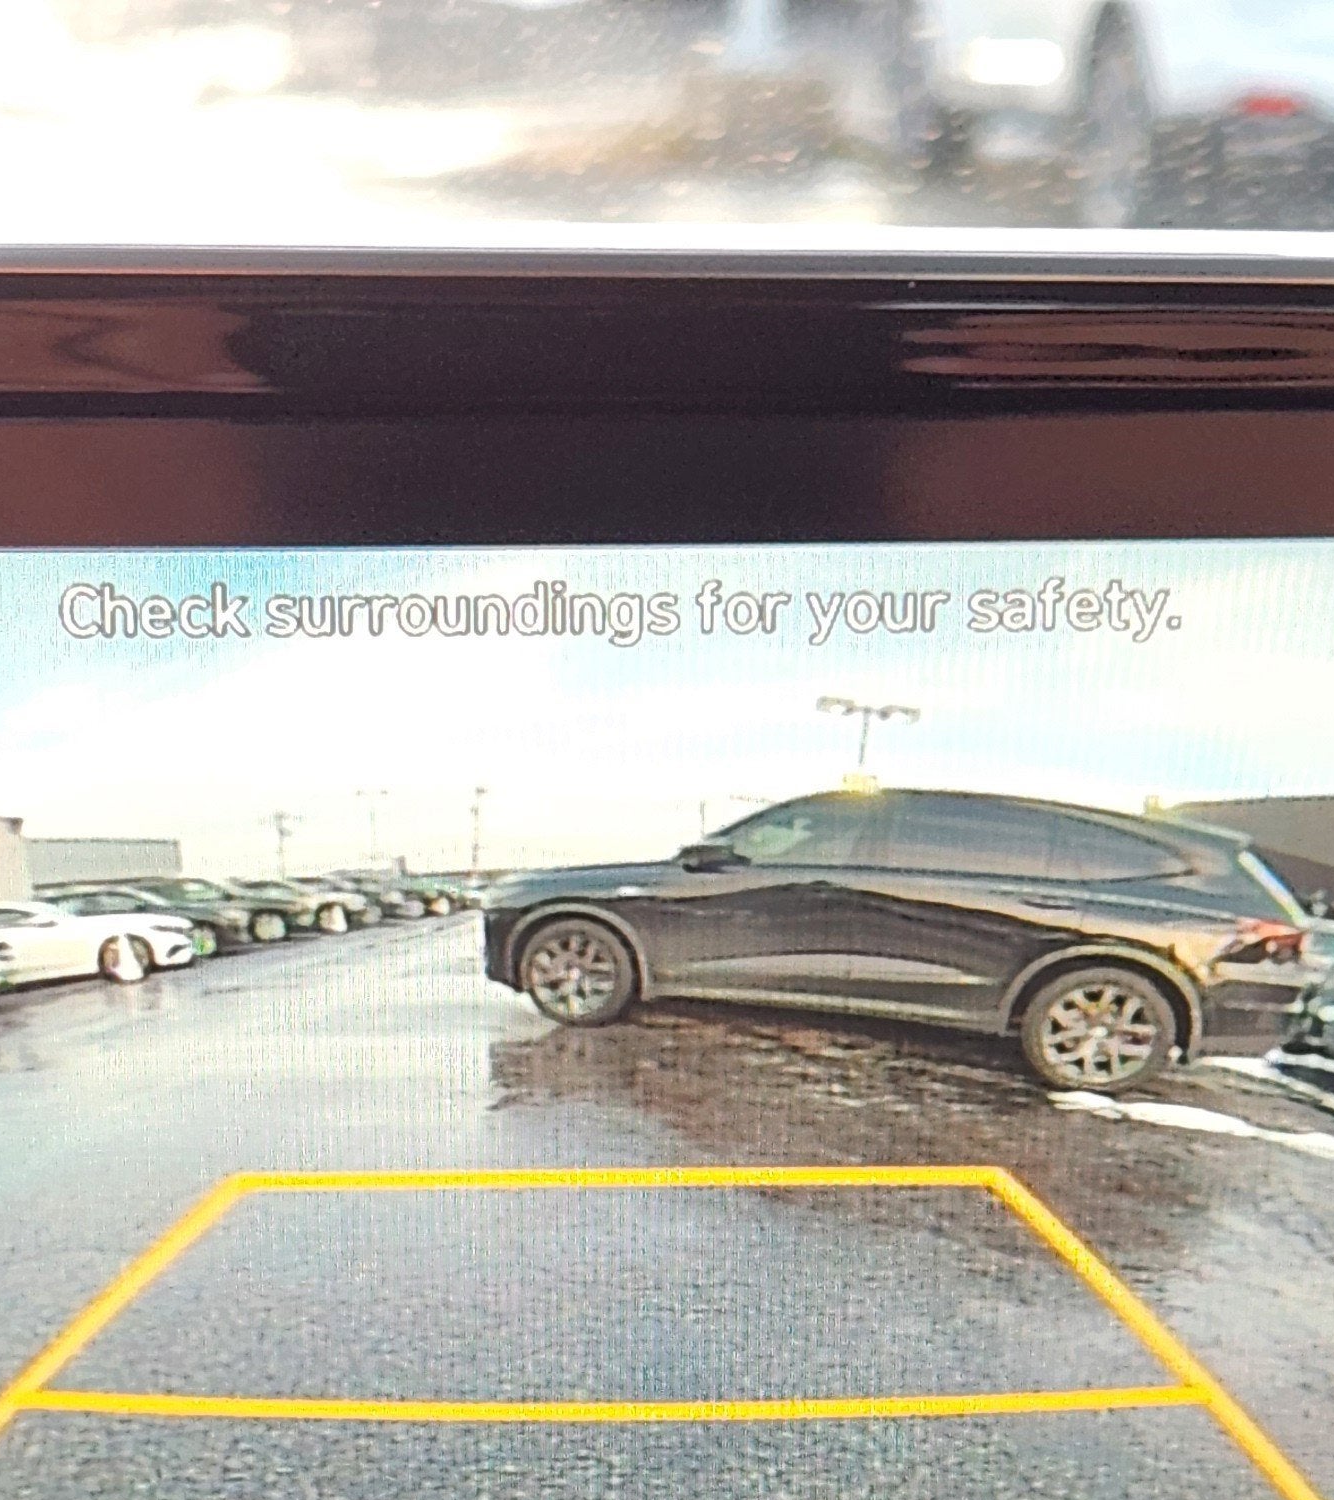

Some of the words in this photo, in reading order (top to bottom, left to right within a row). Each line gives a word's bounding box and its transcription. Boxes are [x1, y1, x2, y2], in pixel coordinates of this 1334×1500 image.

[59, 582, 251, 639] Check
[265, 580, 680, 648] surroundings
[694, 579, 791, 635] for
[805, 590, 951, 646] your
[967, 576, 1182, 644] safety.
